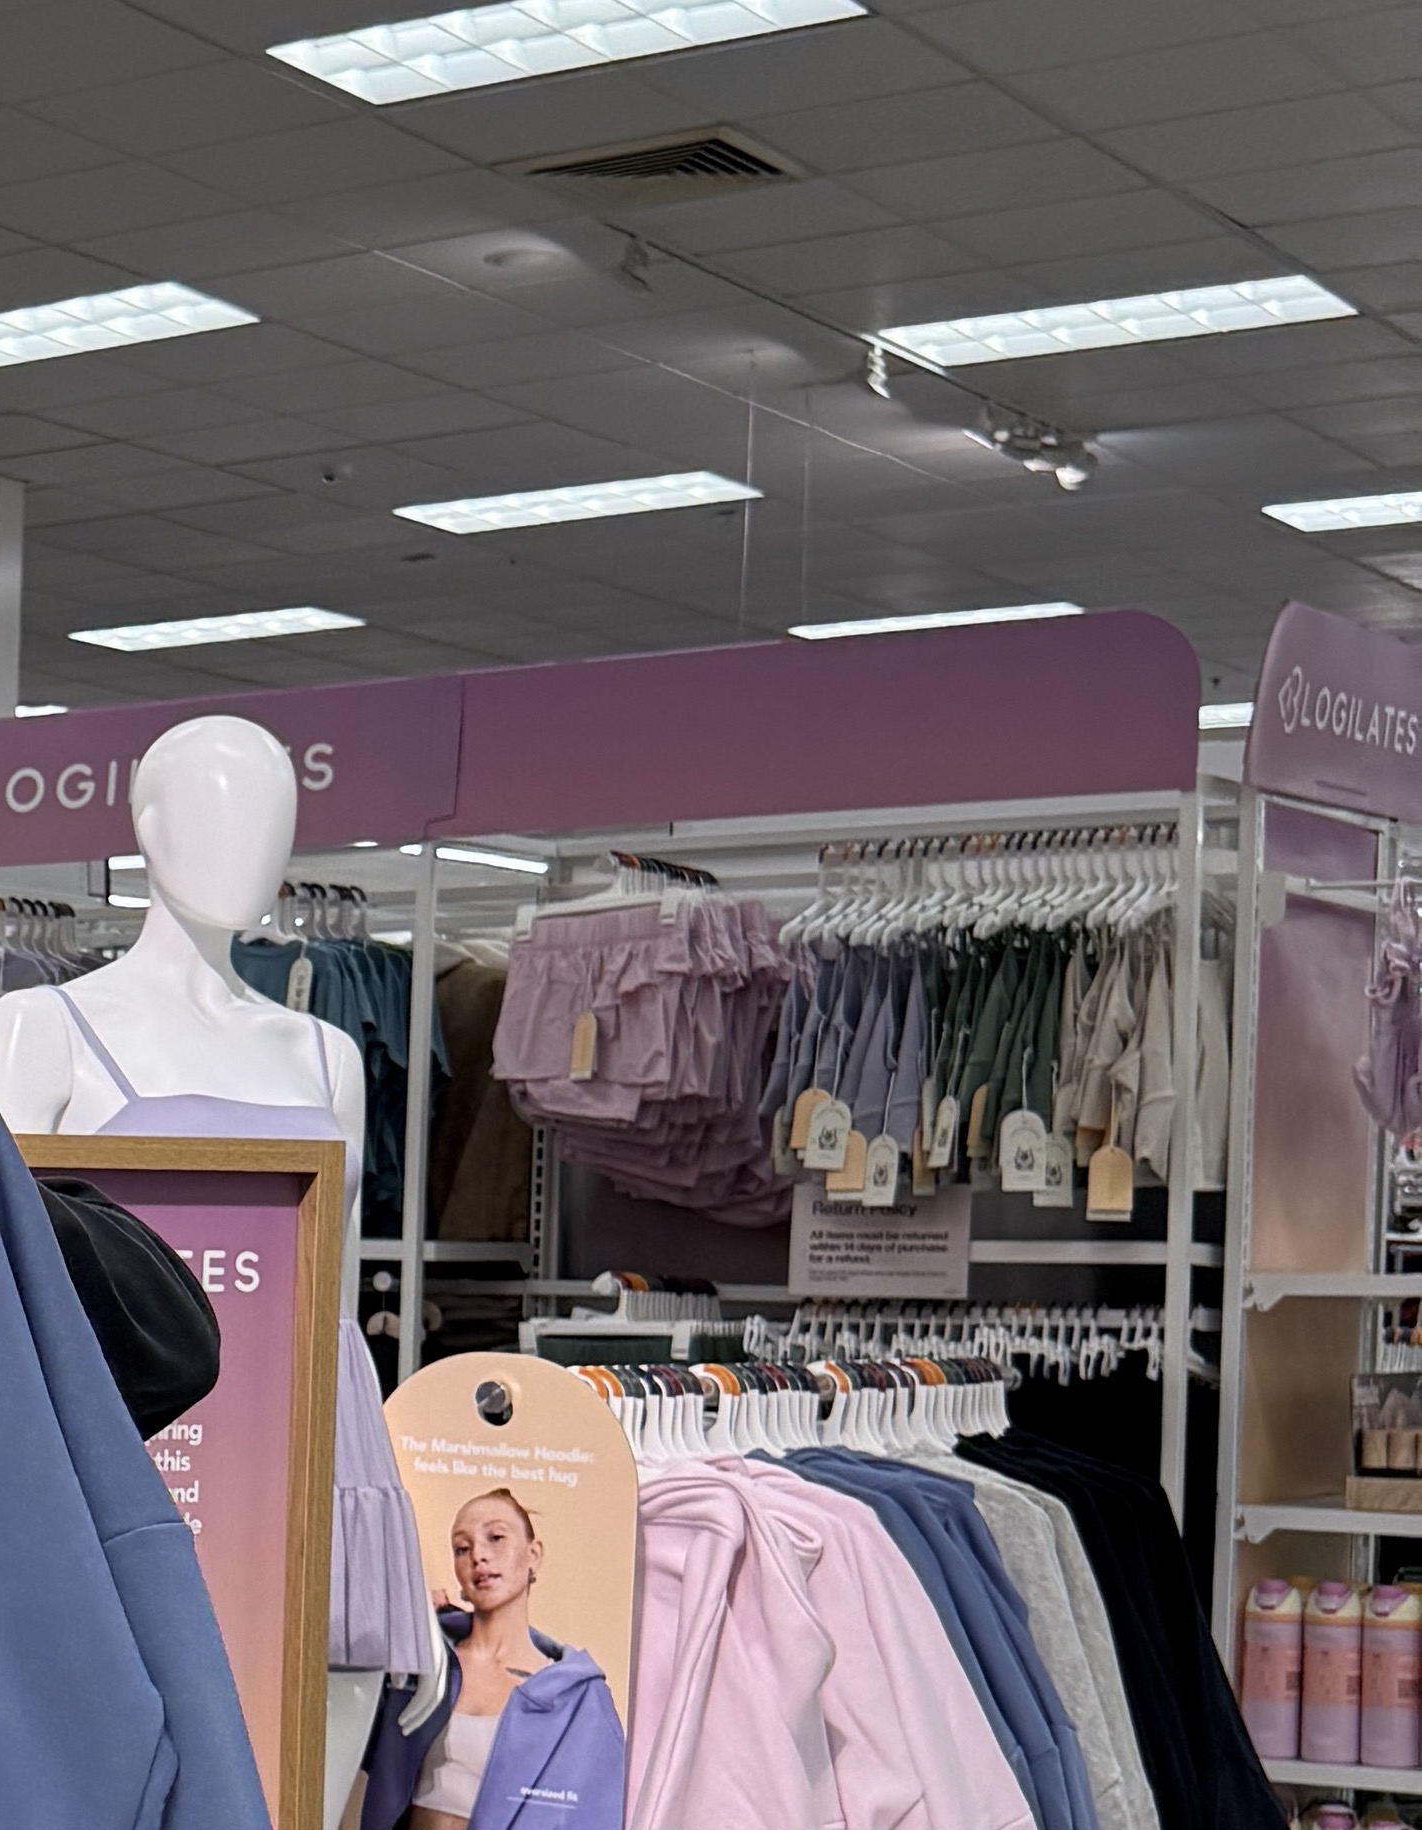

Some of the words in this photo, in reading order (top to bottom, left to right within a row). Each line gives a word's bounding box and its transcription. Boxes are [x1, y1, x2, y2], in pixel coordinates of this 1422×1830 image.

[400, 1435, 427, 1451] The
[431, 1438, 530, 1459] Marshmallow
[414, 1457, 448, 1474] feels
[452, 1459, 478, 1476] like
[482, 1462, 506, 1479] the
[511, 1464, 546, 1482] best
[549, 1468, 579, 1488] hug
